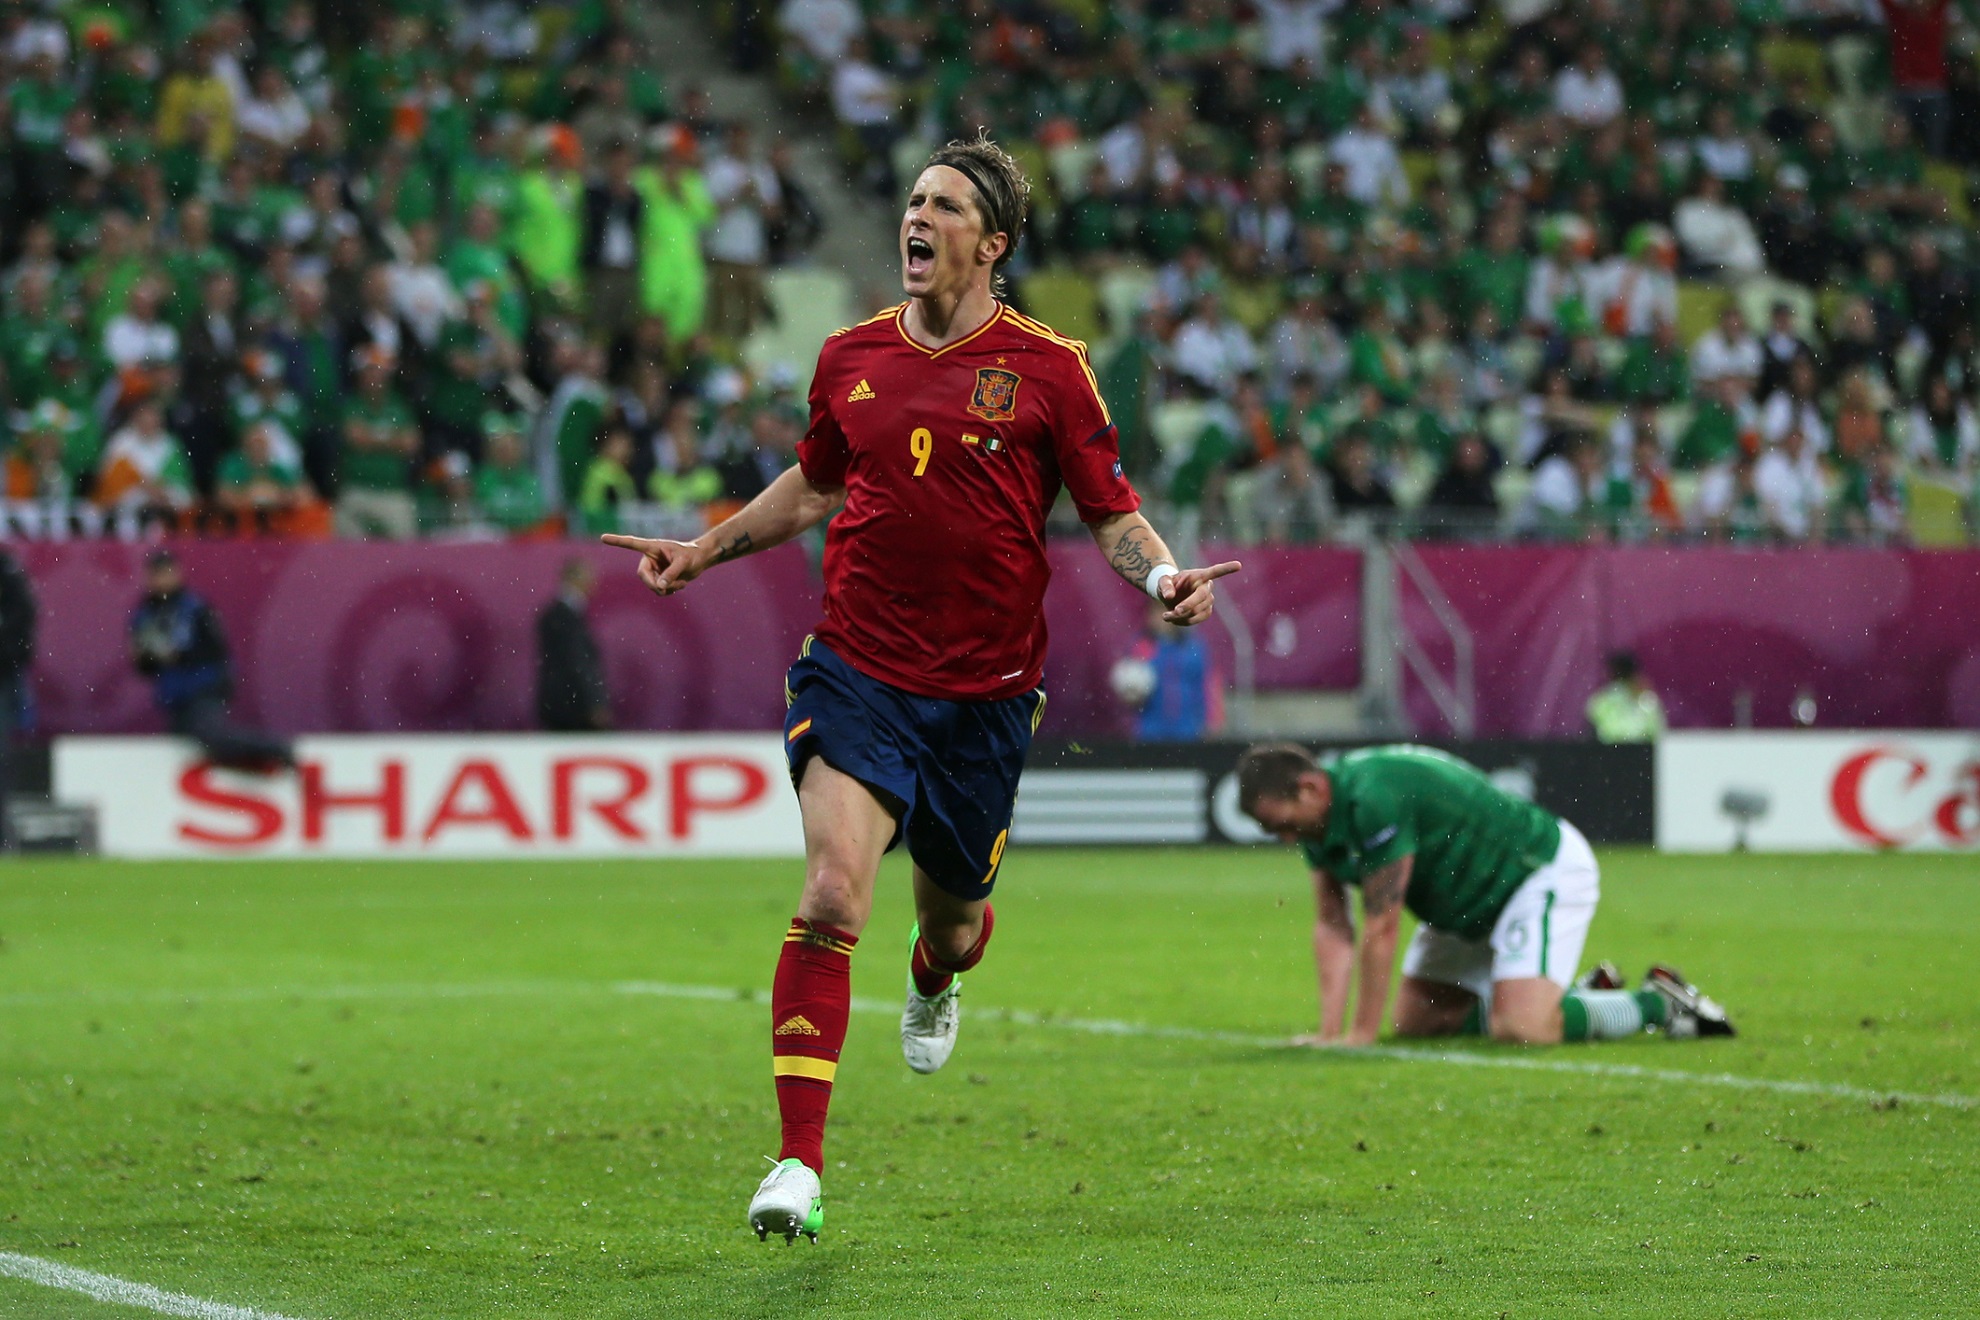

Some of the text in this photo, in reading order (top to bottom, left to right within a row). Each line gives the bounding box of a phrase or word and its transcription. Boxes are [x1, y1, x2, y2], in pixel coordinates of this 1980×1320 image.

[847, 389, 876, 403] adidas
[910, 428, 933, 476] 9
[176, 754, 769, 847] SHARP
[981, 828, 1008, 883] 9
[1504, 918, 1529, 953] 6
[775, 1026, 821, 1037] adidas
